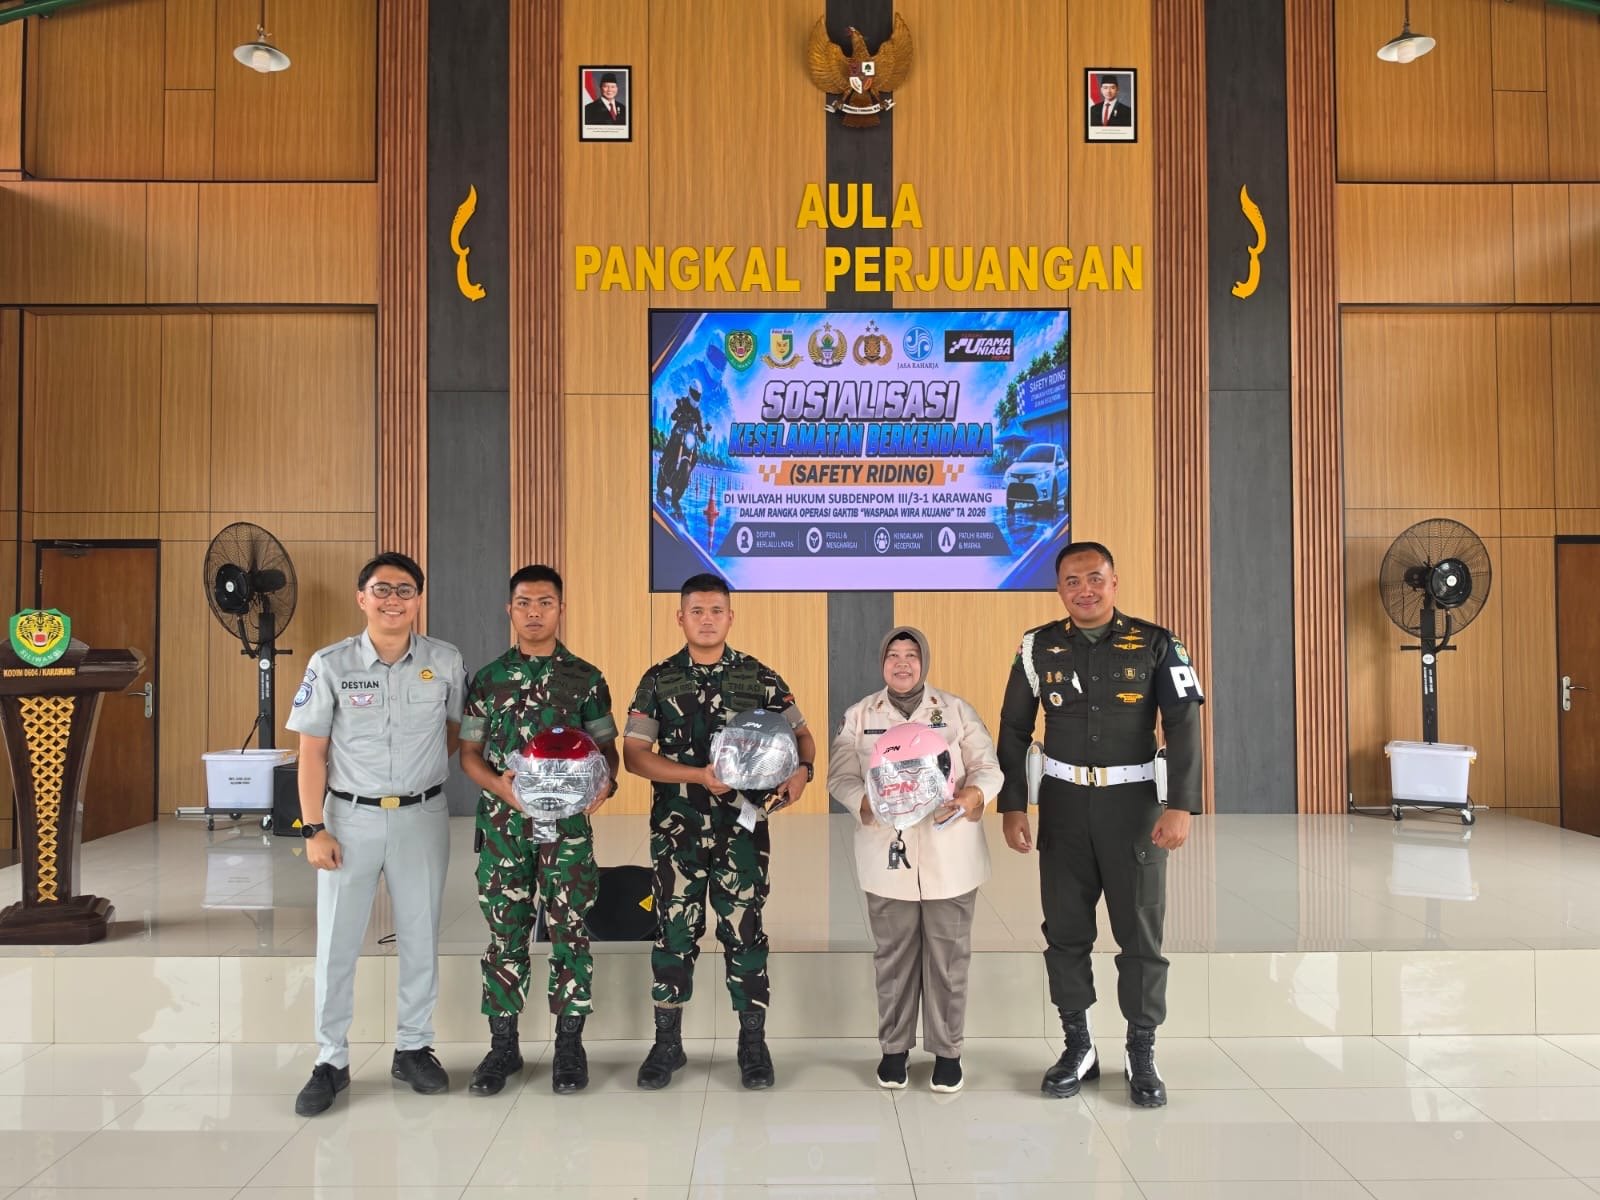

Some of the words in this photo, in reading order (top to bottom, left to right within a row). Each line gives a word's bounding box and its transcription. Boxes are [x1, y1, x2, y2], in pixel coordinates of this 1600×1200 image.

[796, 183, 923, 229] AULA
[575, 246, 800, 292] PANGKAL
[825, 245, 1143, 292] PERJUANGAN
[977, 346, 1010, 356] NIAGA
[762, 380, 960, 422] SOSIALISASI
[729, 423, 865, 458] KESELAMATAN
[867, 422, 993, 458] BERKENDARA
[790, 463, 862, 484] (SAFETY
[866, 462, 935, 484] RIDING)
[724, 494, 734, 504] DI
[737, 494, 782, 504] WILAYAH
[786, 494, 825, 504] HUKUM
[828, 493, 894, 504] SUBDENPOM
[898, 492, 929, 505] III/3-1
[932, 493, 992, 503] KARAWANG
[740, 508, 766, 518] DALAM
[767, 508, 798, 518] RANGKA
[800, 508, 830, 518] OPERASI
[832, 508, 859, 518] GAKTIB
[901, 508, 920, 518] WIRA
[956, 508, 965, 518] TA
[967, 508, 986, 518] 2026
[342, 681, 379, 689] DESTIAN
[883, 745, 900, 754] JPN
[880, 782, 914, 796] JPN
